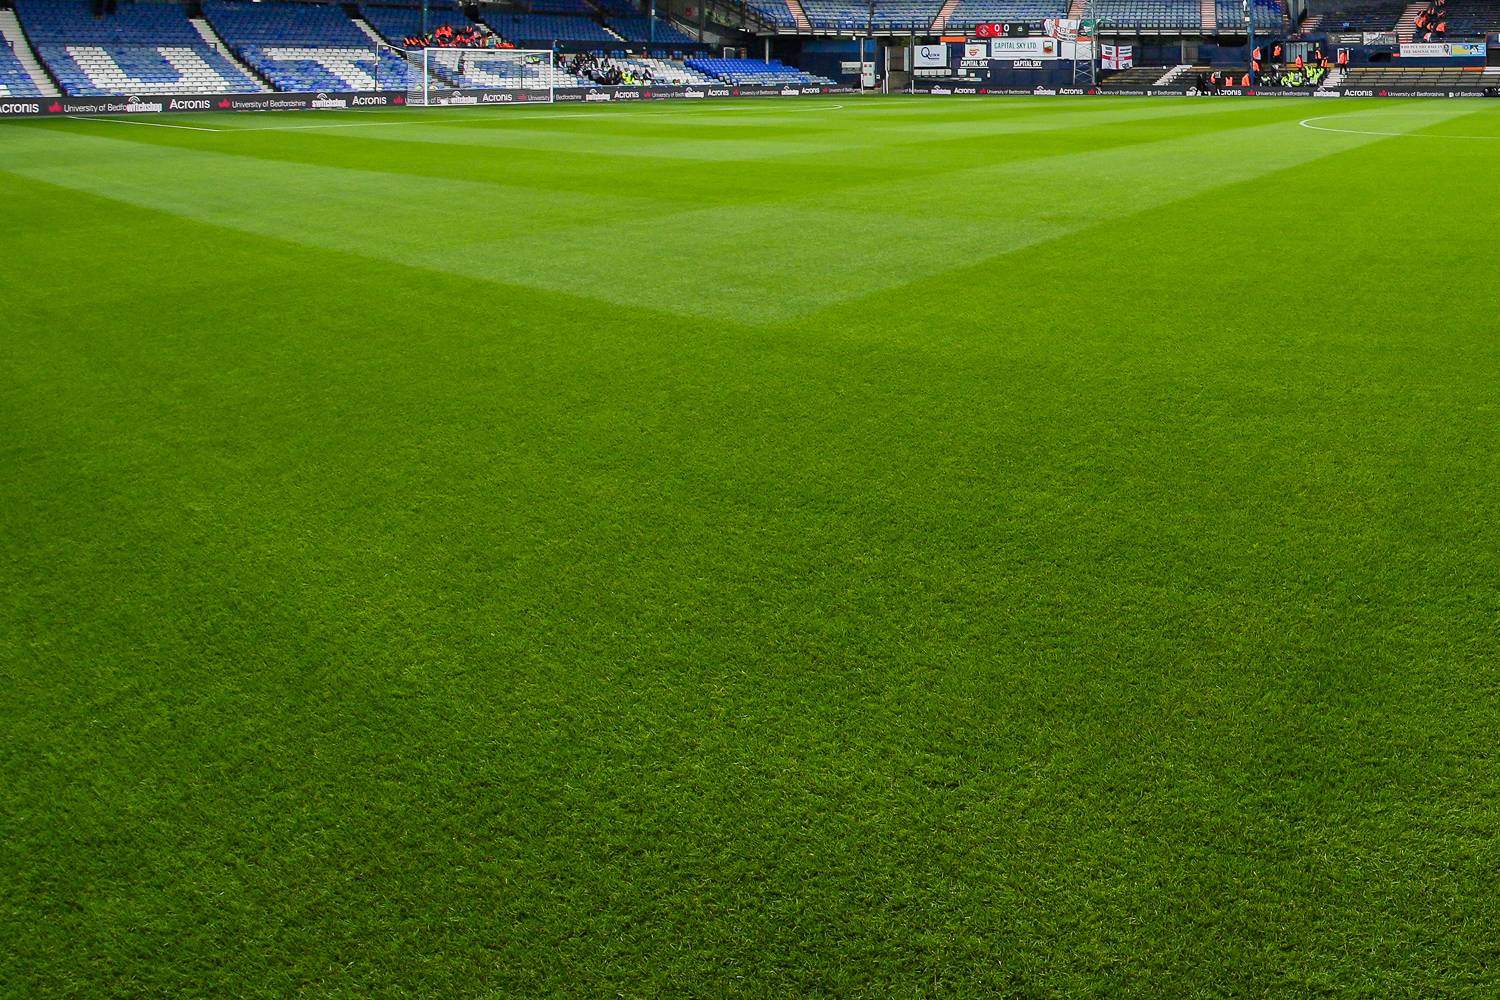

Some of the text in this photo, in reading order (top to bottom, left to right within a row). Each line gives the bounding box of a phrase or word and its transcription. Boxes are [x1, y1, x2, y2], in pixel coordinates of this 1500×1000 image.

[994, 24, 1000, 32] 0
[1004, 24, 1010, 32] 0
[482, 93, 513, 102] Acronis
[613, 90, 640, 99] Acronis
[707, 89, 730, 97] Acronis
[1344, 89, 1373, 97] Acronis
[169, 98, 211, 110] Acronis
[231, 99, 307, 110] University of Bedfordshire
[351, 95, 388, 106] Acronis
[64, 103, 106, 114] University of
